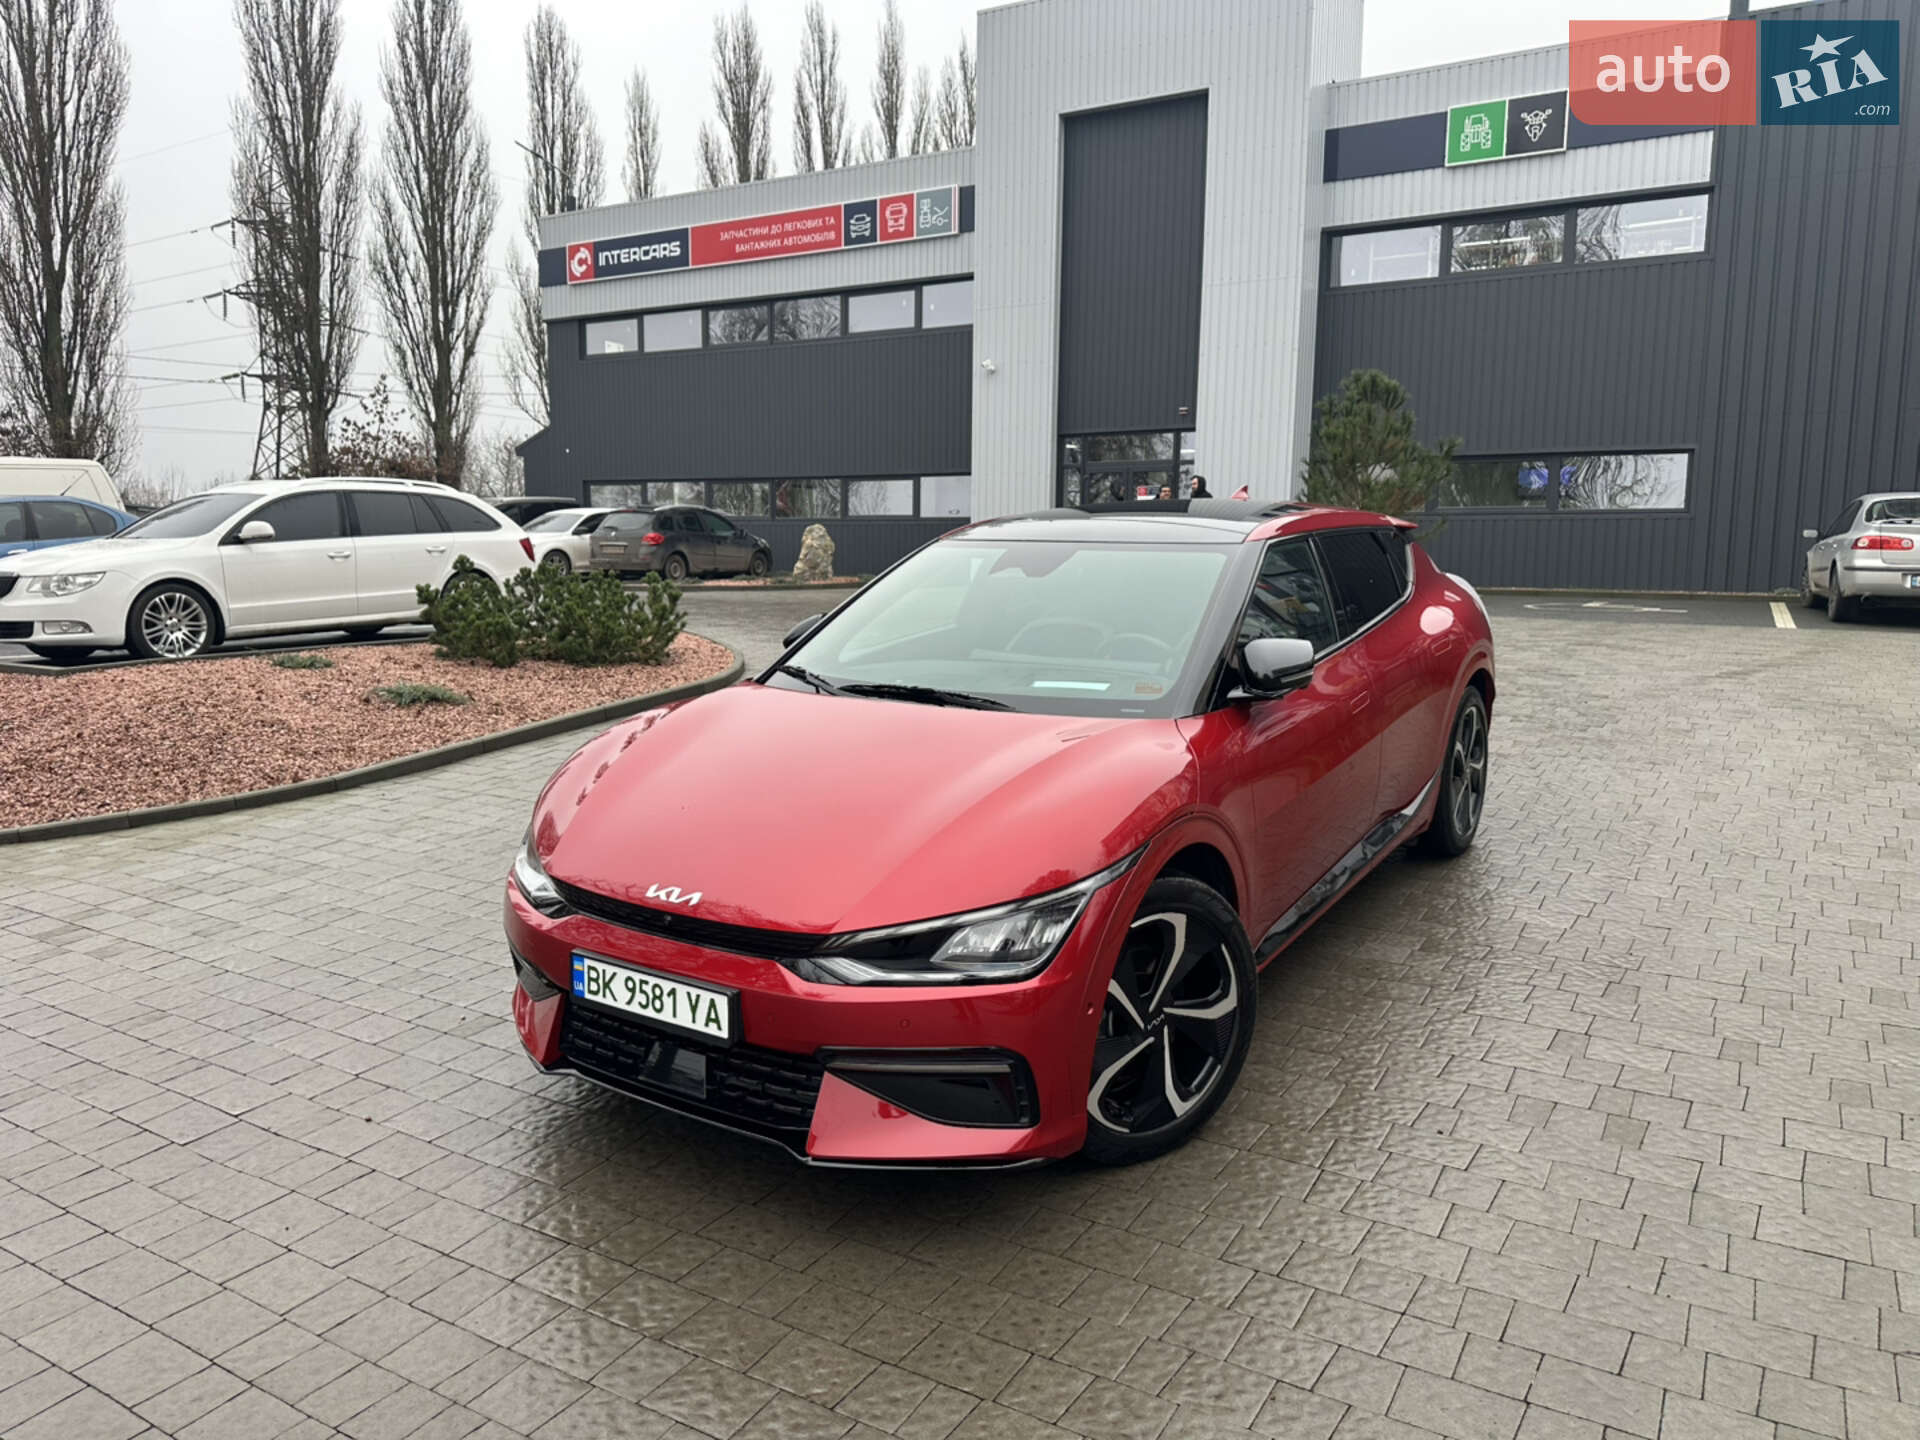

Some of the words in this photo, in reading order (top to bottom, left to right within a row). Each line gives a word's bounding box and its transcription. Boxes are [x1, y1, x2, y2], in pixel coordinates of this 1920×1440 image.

[720, 225, 769, 240] ЗАПЧАСТИНИ
[770, 223, 782, 235] ДО
[784, 217, 824, 232] ЛЕГКОВИХ
[825, 216, 836, 225] ТА
[598, 241, 681, 266] INTERCARS
[735, 238, 782, 253] ВАНТАЖНИХ
[783, 231, 836, 246] АВТОМОБІЛІВ
[573, 980, 584, 991] UA
[587, 965, 618, 1002] BK
[624, 975, 677, 1018] 9581
[686, 991, 722, 1031] YA
